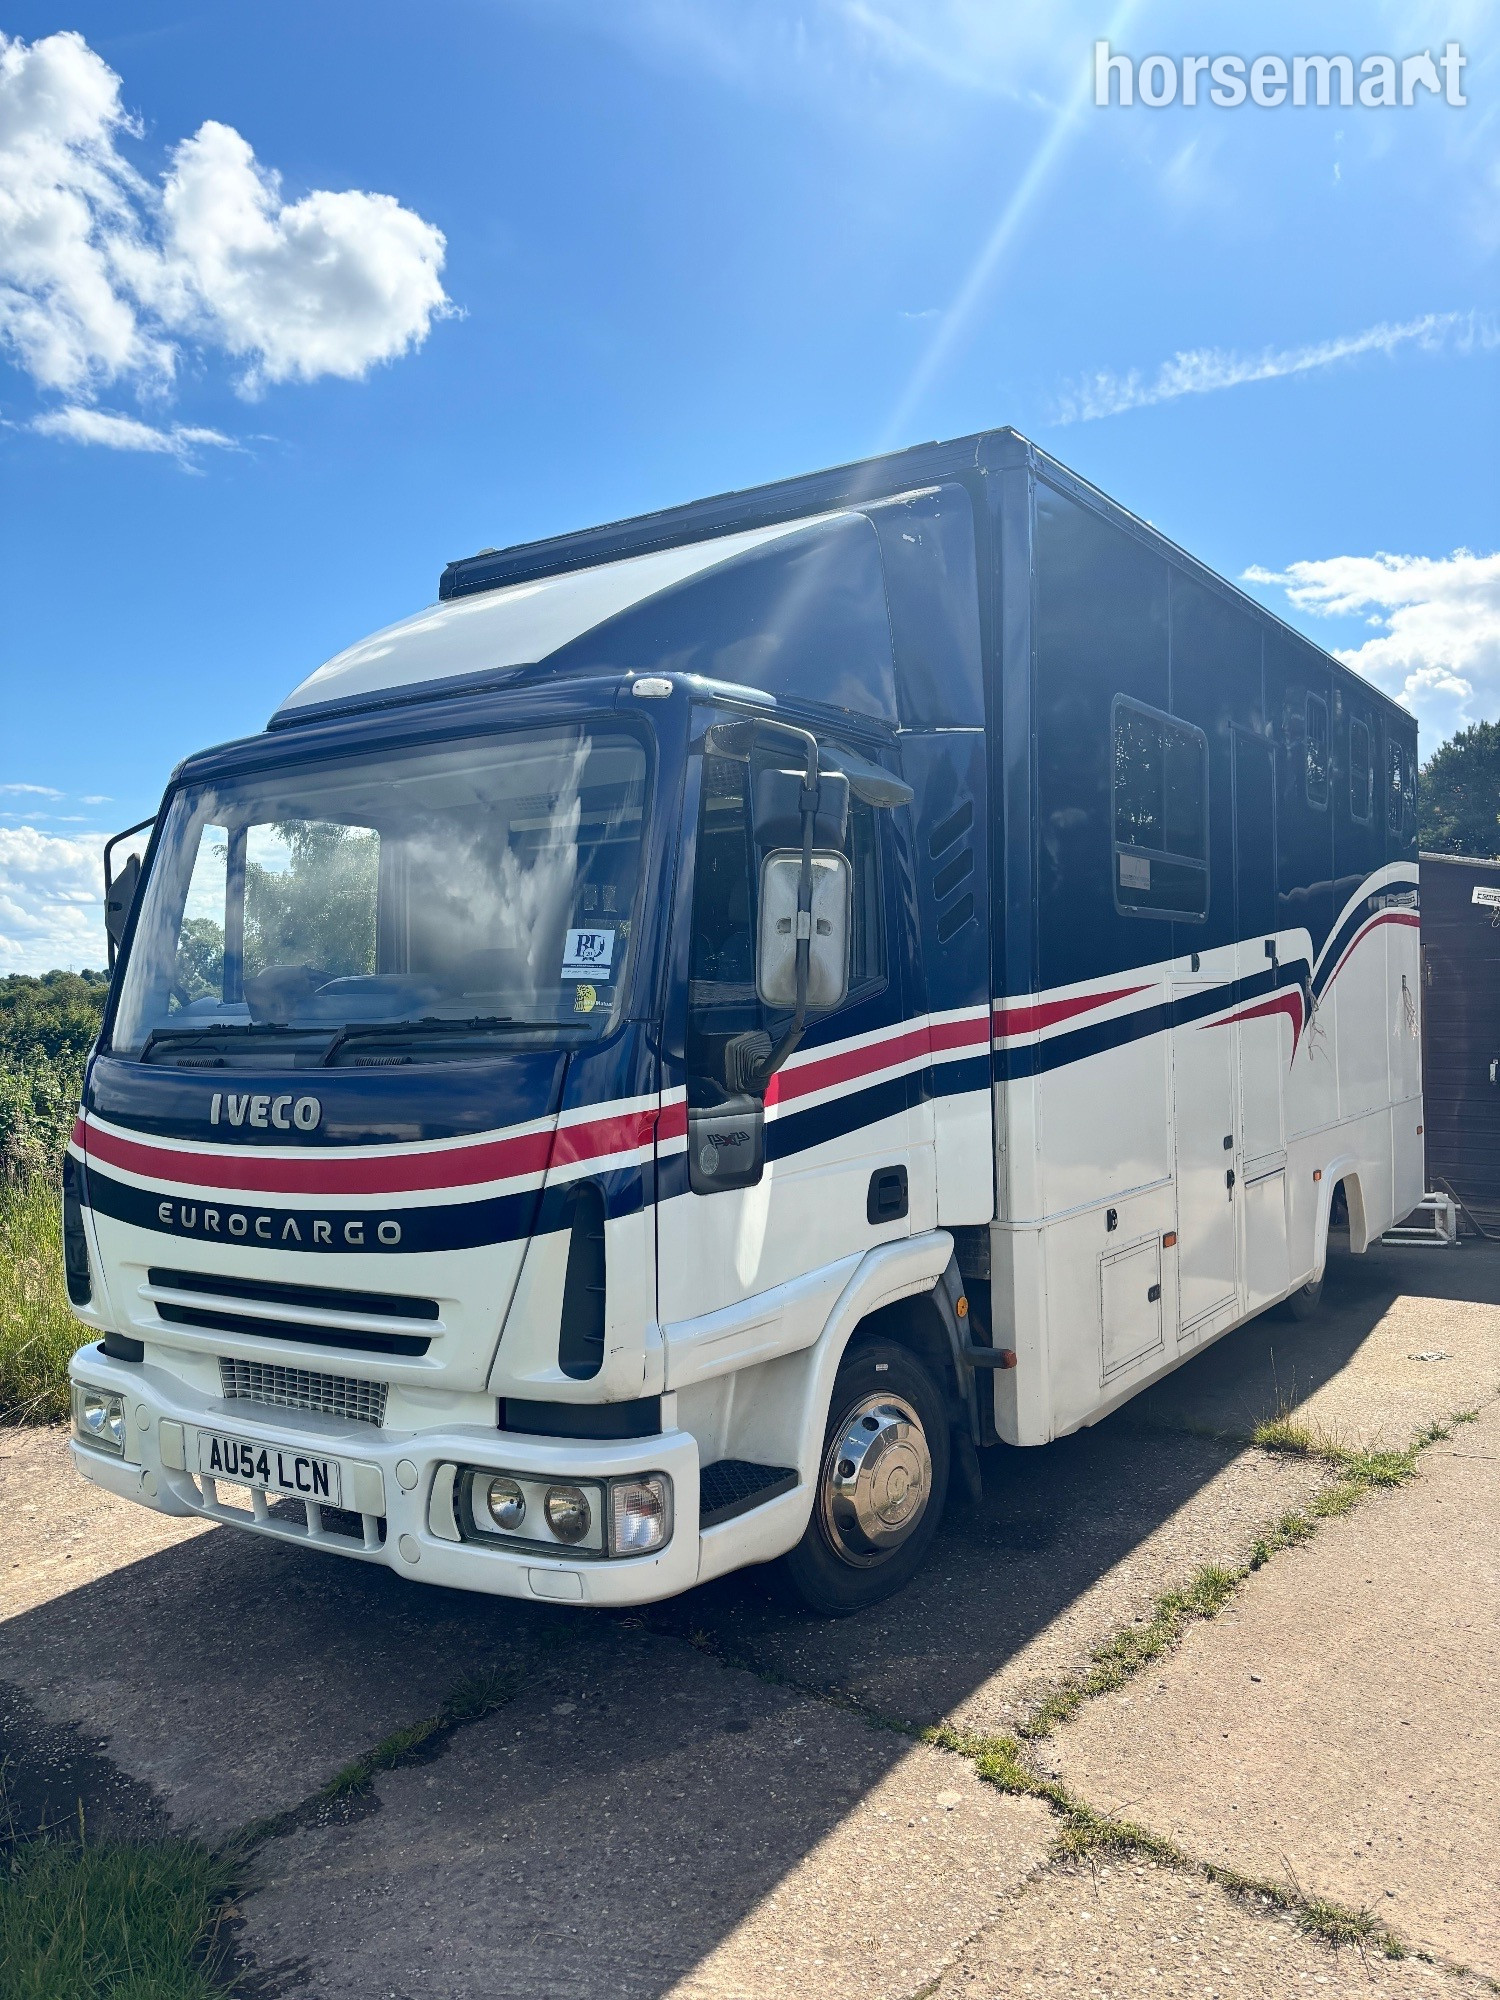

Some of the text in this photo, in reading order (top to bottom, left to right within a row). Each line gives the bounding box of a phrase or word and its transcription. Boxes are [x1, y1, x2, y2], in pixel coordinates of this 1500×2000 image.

[210, 1093, 321, 1130] IVECO
[158, 1202, 402, 1245] EUROCARGO
[210, 1438, 329, 1496] AU54 LCN
